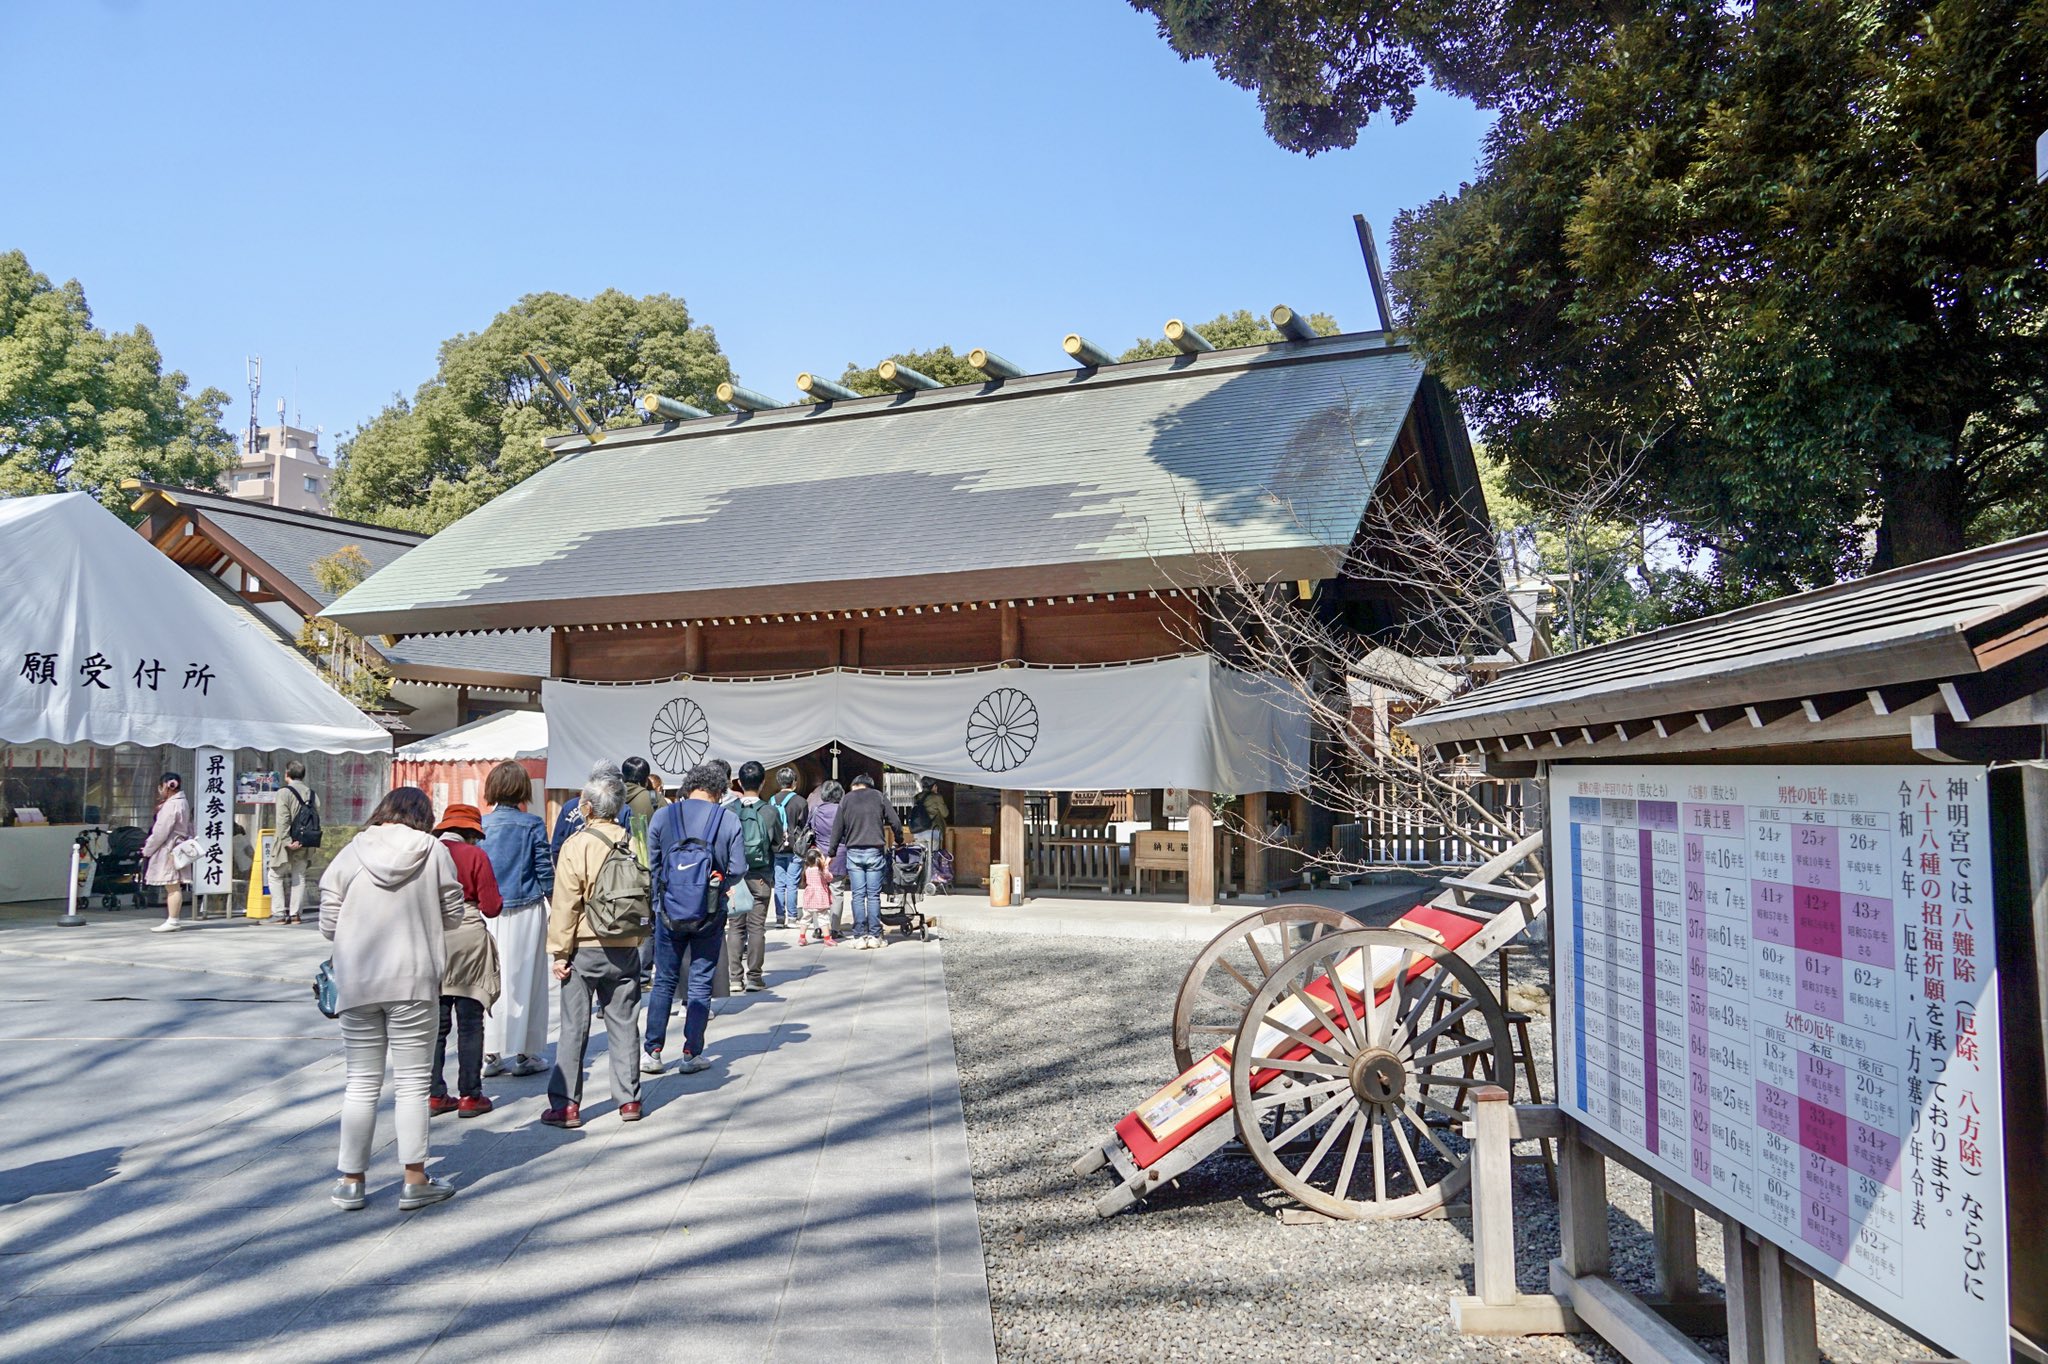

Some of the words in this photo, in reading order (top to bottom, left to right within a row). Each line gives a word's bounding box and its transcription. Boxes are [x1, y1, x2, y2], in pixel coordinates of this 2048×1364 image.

[20, 652, 215, 696] 願受付所
[1778, 786, 1828, 805] 男性の厄年
[204, 756, 226, 886] 昇殿参拝受付
[1694, 810, 1731, 830] 五黄土星
[1760, 809, 1780, 820] 前厄
[1802, 811, 1825, 823] 本厄
[1851, 814, 1876, 826] 後厄
[1759, 826, 1781, 841] 24才
[1801, 829, 1826, 846] 25才
[1850, 833, 1878, 851] 26才
[1705, 848, 1744, 869] 平成16年生
[1761, 887, 1783, 903] 41才
[1804, 893, 1829, 911] 42才
[1852, 901, 1880, 920] 43才
[1707, 923, 1747, 950] 昭和61年生
[1762, 946, 1785, 964] 60才
[1805, 956, 1831, 975] 61才
[1708, 966, 1748, 990] 昭和52年生
[1854, 968, 1883, 988] 62才
[1917, 779, 1952, 1217] 八十八種の招福祈願を承っております。
[1708, 1006, 1749, 1031] 昭和43年生
[1785, 1011, 1835, 1043] 女性の厄年
[1766, 1027, 1786, 1042] 前厄
[1709, 1046, 1749, 1076] 昭和34年生
[1765, 1042, 1787, 1061] 18才
[1809, 1042, 1832, 1059] 本厄
[1808, 1057, 1834, 1079] 19才
[1858, 1058, 1884, 1077] 後厄
[1857, 1074, 1886, 1098] 20才
[1710, 1086, 1750, 1116] 昭和25年生
[1765, 1088, 1788, 1109] 32才
[1809, 1108, 1835, 1128] 33才
[1712, 1124, 1751, 1157] 昭和16年生
[1766, 1132, 1790, 1153] 36才
[1858, 1126, 1887, 1151] 34才
[1811, 1152, 1837, 1177] 37才
[1768, 1178, 1790, 1200] 60才
[1859, 1176, 1888, 1202] 38才
[1812, 1200, 1837, 1226] 61才
[1860, 1227, 1890, 1254] 62才
